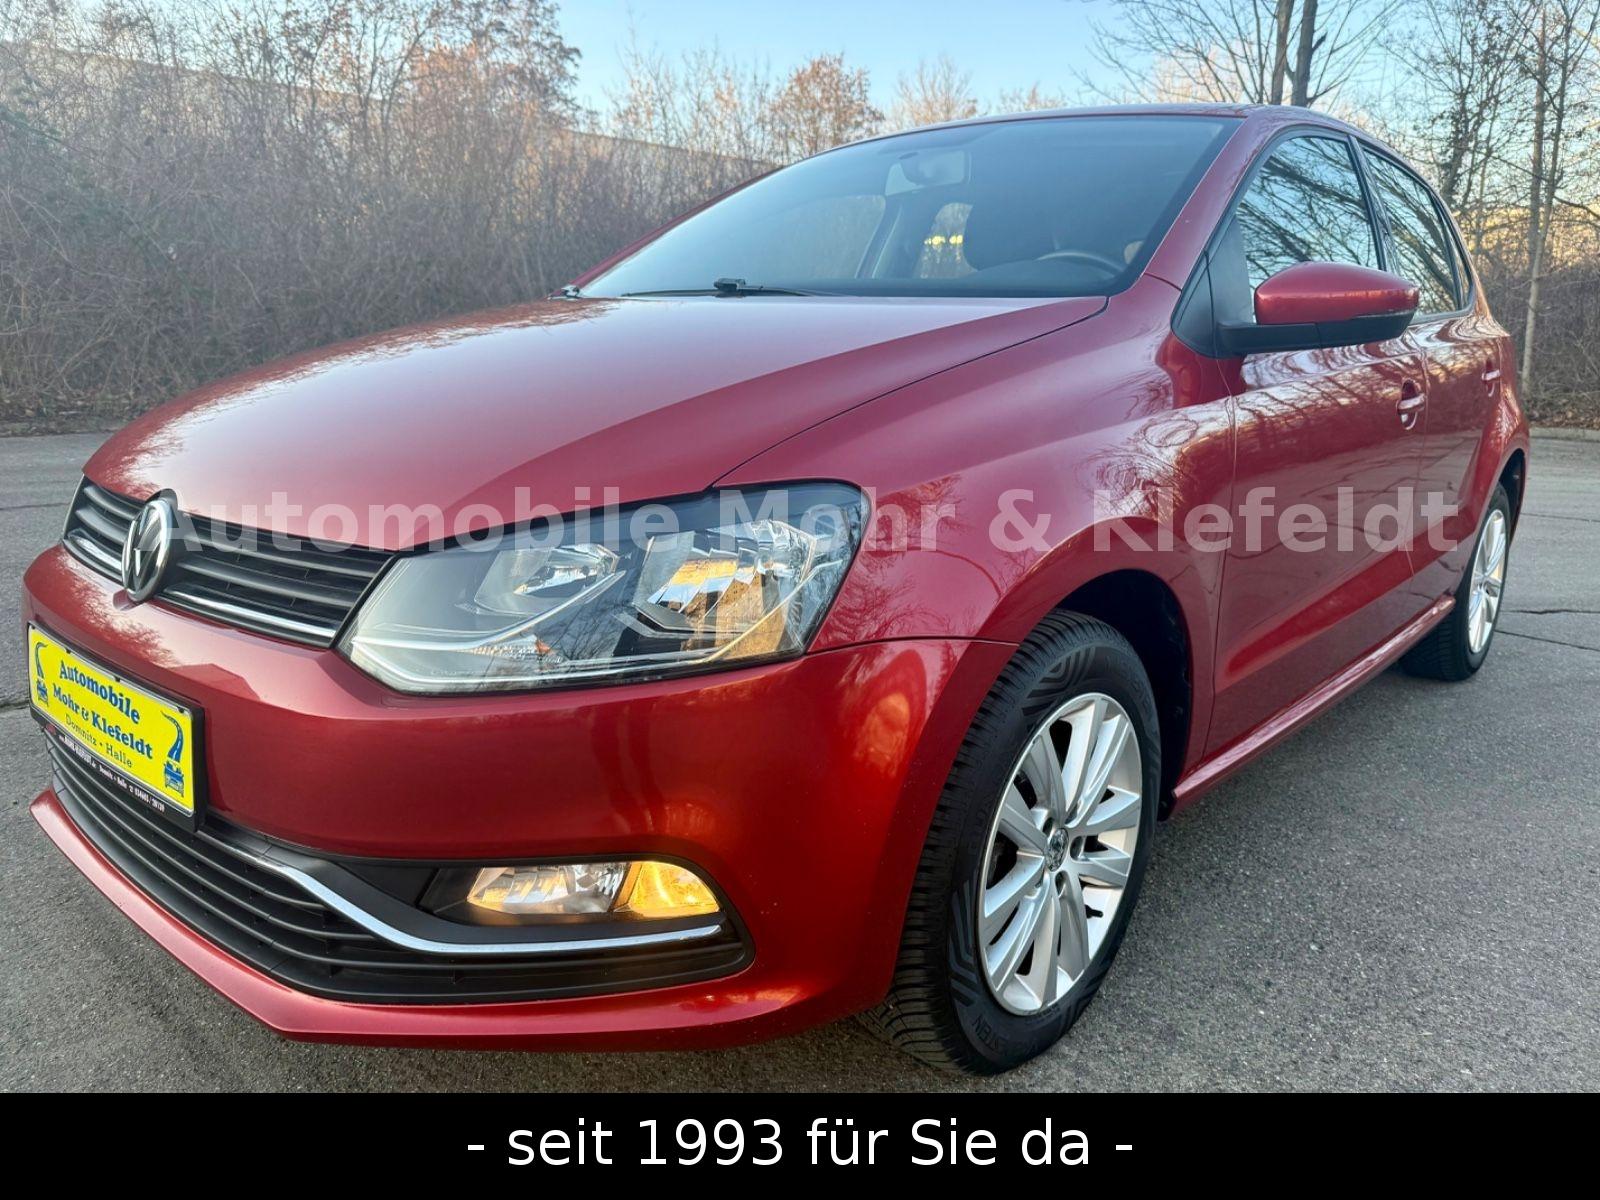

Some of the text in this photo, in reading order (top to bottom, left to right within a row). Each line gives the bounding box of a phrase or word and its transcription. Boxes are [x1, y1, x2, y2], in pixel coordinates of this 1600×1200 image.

[53, 683, 80, 716] Mohr
[81, 707, 89, 721] &
[91, 710, 153, 760] Klefeldt
[59, 660, 140, 724] Automobile
[105, 743, 132, 768] Halle
